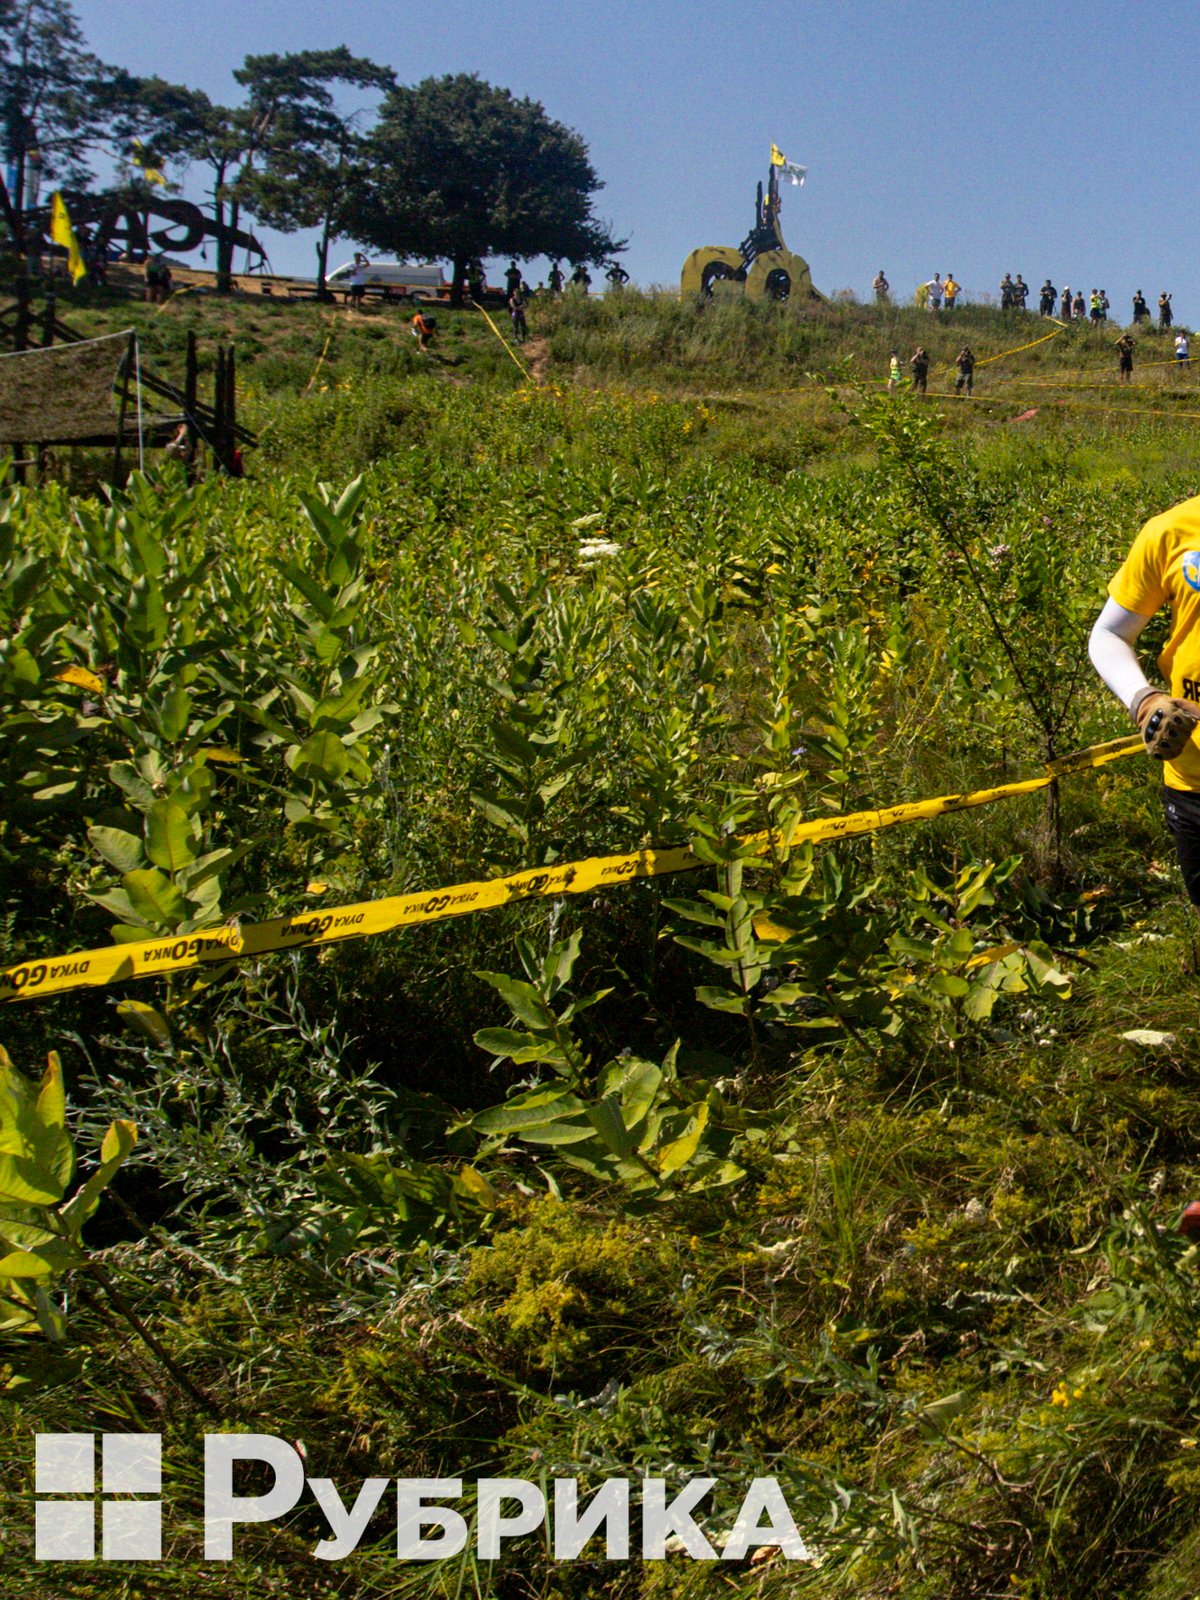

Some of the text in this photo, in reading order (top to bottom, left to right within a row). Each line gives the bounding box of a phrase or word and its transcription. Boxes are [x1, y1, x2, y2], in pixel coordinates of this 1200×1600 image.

[334, 913, 365, 927] DYKA
[143, 938, 204, 962] GONKA
[50, 960, 91, 979] DYKA
